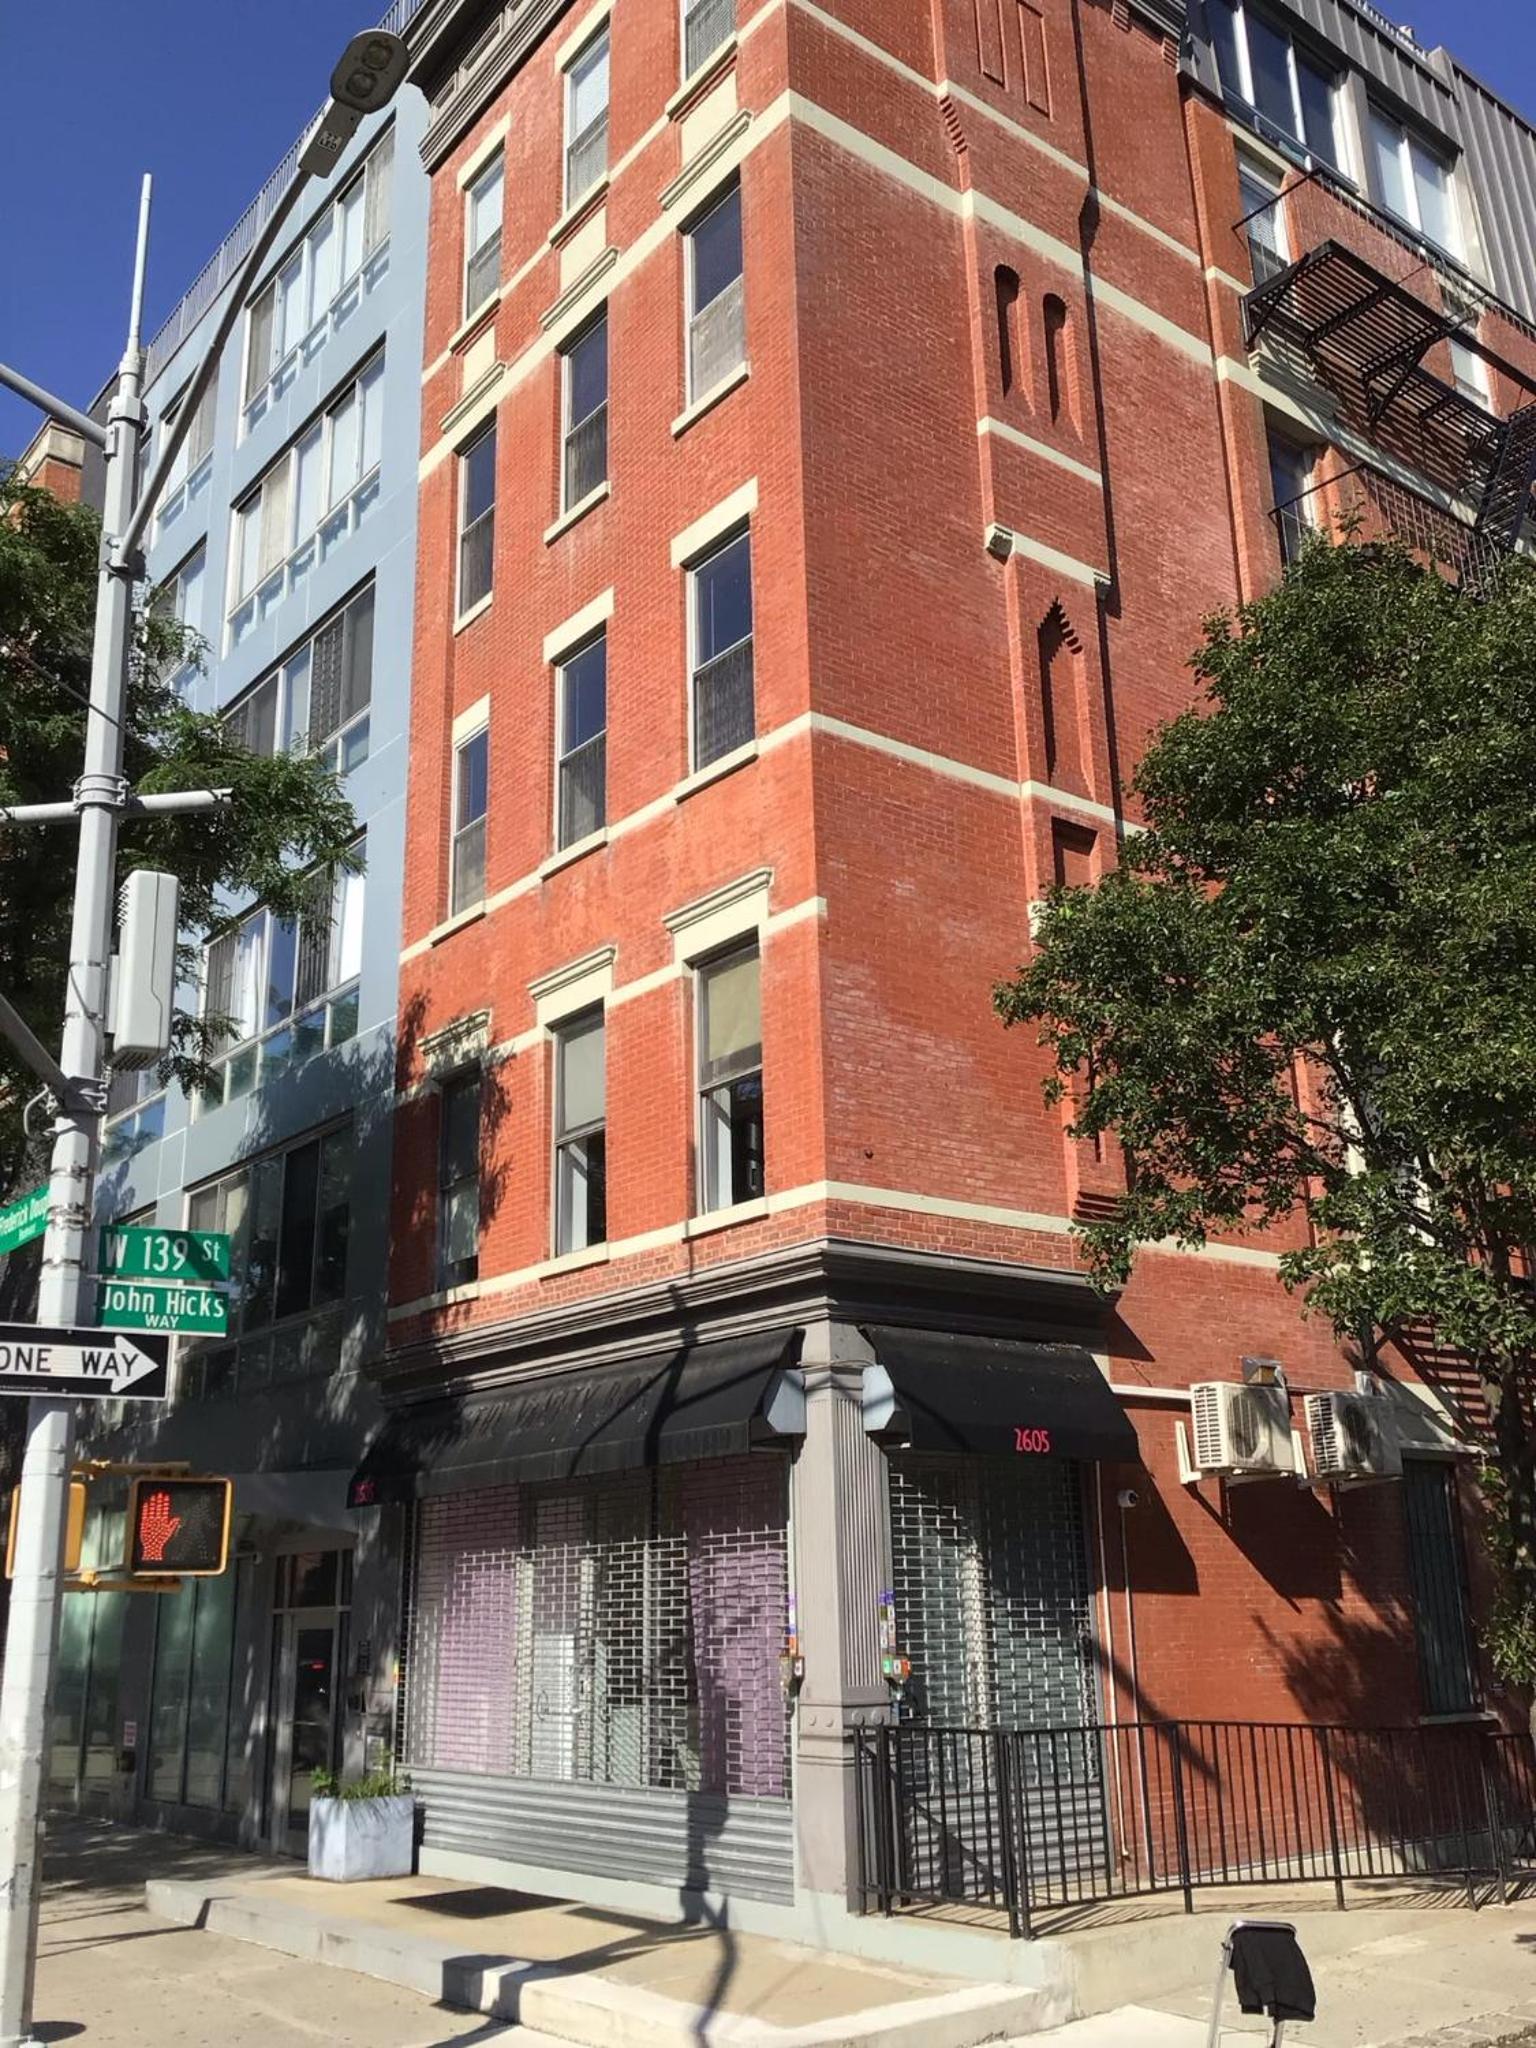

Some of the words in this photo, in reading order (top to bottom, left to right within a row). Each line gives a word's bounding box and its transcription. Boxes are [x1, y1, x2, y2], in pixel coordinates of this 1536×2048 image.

[106, 1233, 128, 1269] W
[143, 1235, 188, 1272] 139
[202, 1239, 221, 1262] St
[102, 1286, 155, 1313] John
[166, 1290, 225, 1318] Hicks
[145, 1314, 180, 1328] WAY
[0, 1345, 52, 1373] ONE
[81, 1350, 140, 1377] WAY
[1014, 1427, 1050, 1453] 2605
